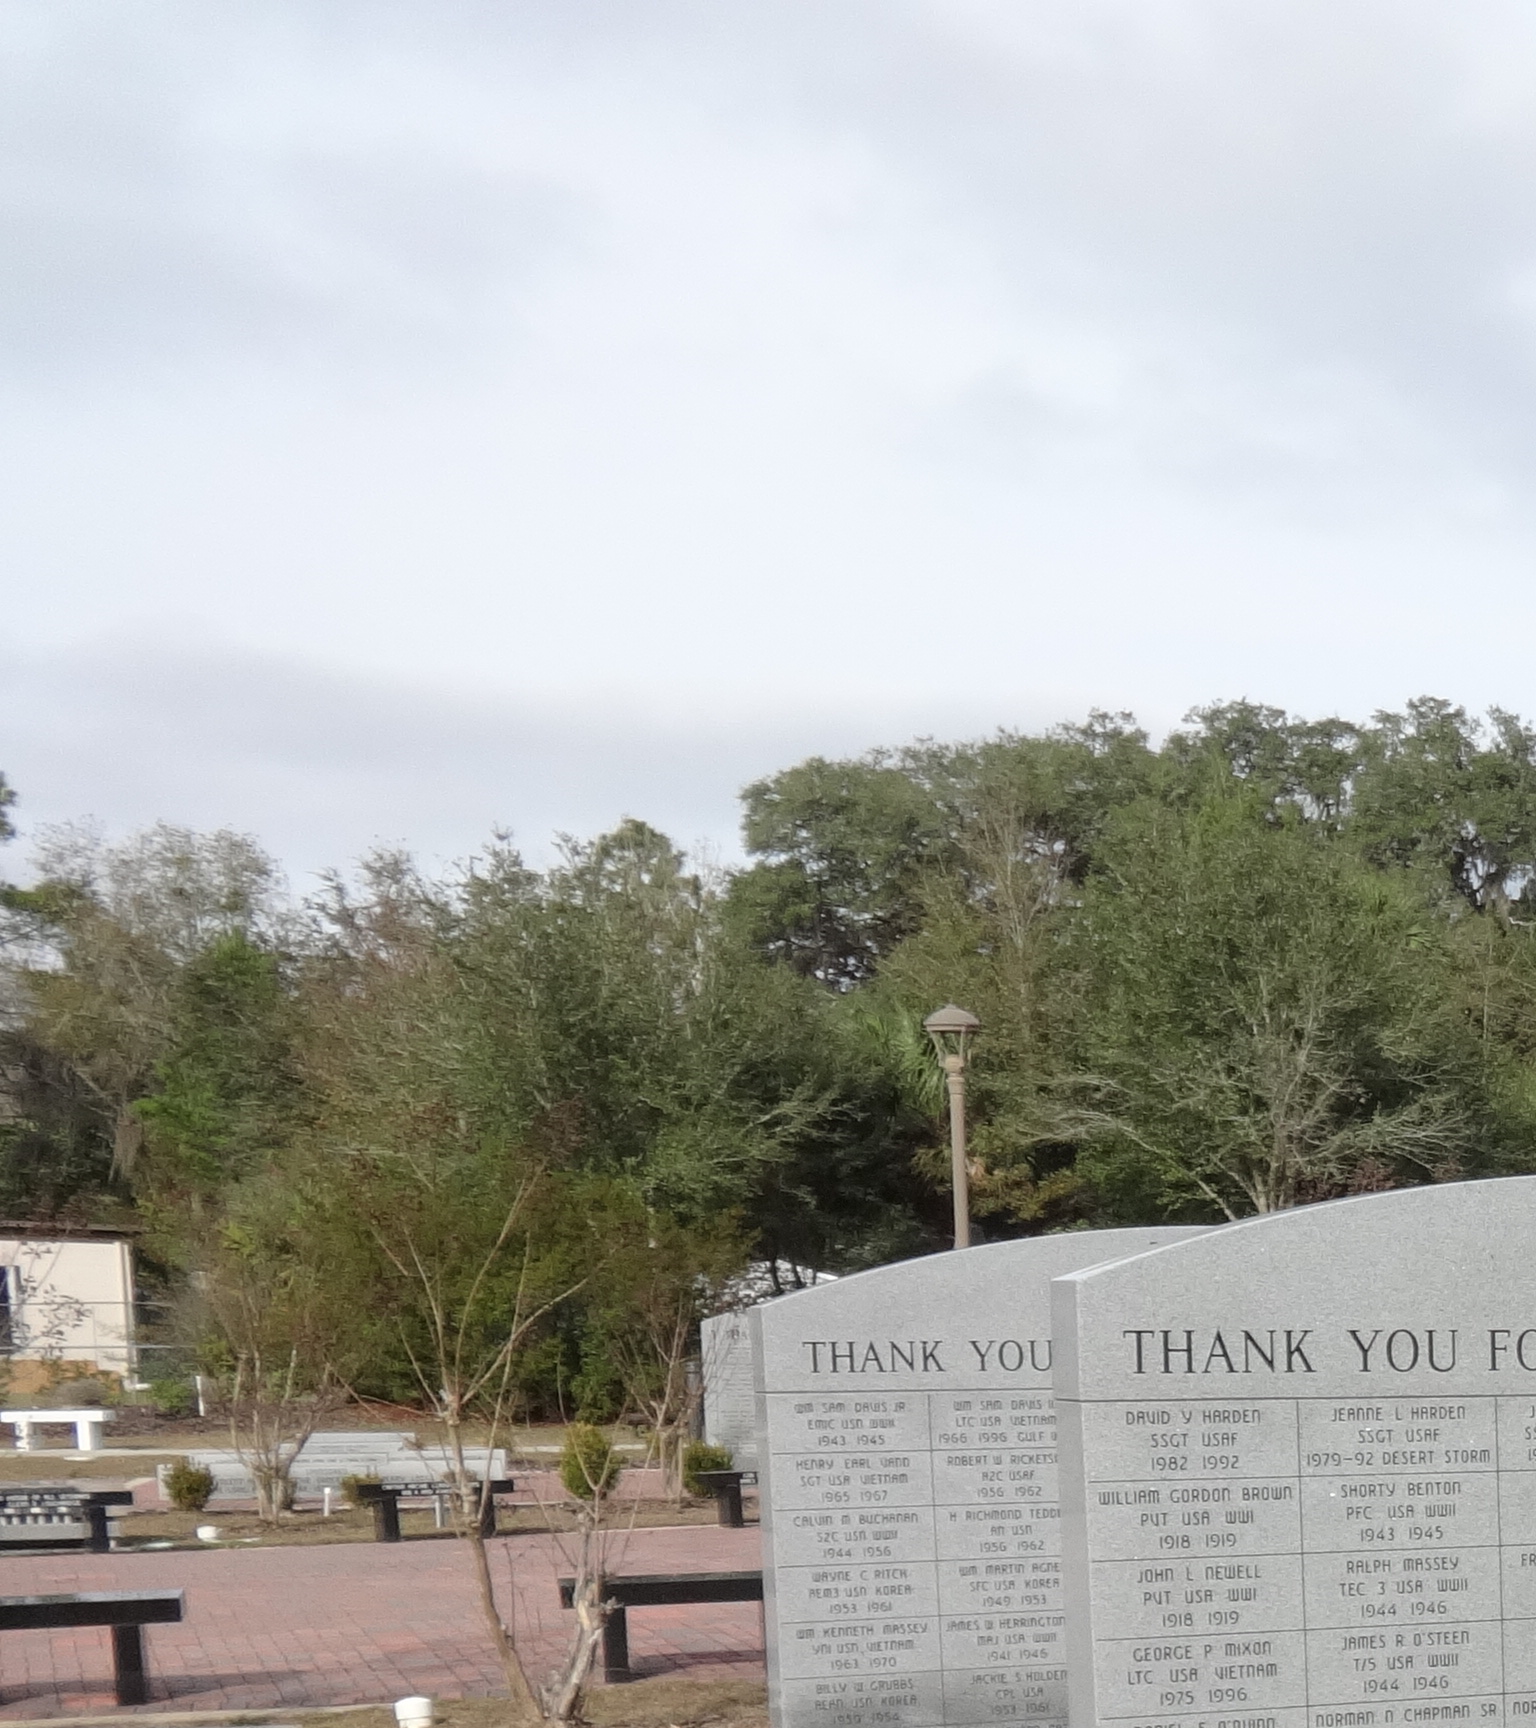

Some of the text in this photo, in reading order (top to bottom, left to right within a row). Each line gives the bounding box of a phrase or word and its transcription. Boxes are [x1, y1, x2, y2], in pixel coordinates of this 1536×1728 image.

[802, 1339, 1052, 1373] THANK YOU
[1124, 1327, 1316, 1376] THANK
[1347, 1326, 1458, 1374] YOU
[1126, 1410, 1171, 1426] DAVID
[1202, 1408, 1261, 1424] HARDEN
[1331, 1405, 1466, 1423] JEANNE L HARDEN
[818, 1434, 885, 1447] 1943 1945
[1150, 1432, 1239, 1448] SSGT USAF
[1357, 1428, 1441, 1444] SSGT USAF
[1151, 1455, 1240, 1472] 1982 1992
[1306, 1449, 1491, 1467] 1979-92 DESERT STORM
[821, 1490, 888, 1503] 1965 1967
[1098, 1486, 1292, 1506] WILLIAM GORDON BROWN
[1140, 1510, 1255, 1527] PVT USA WWI
[1159, 1533, 1237, 1550] 1918 1919
[823, 1546, 891, 1559] 1944 1956
